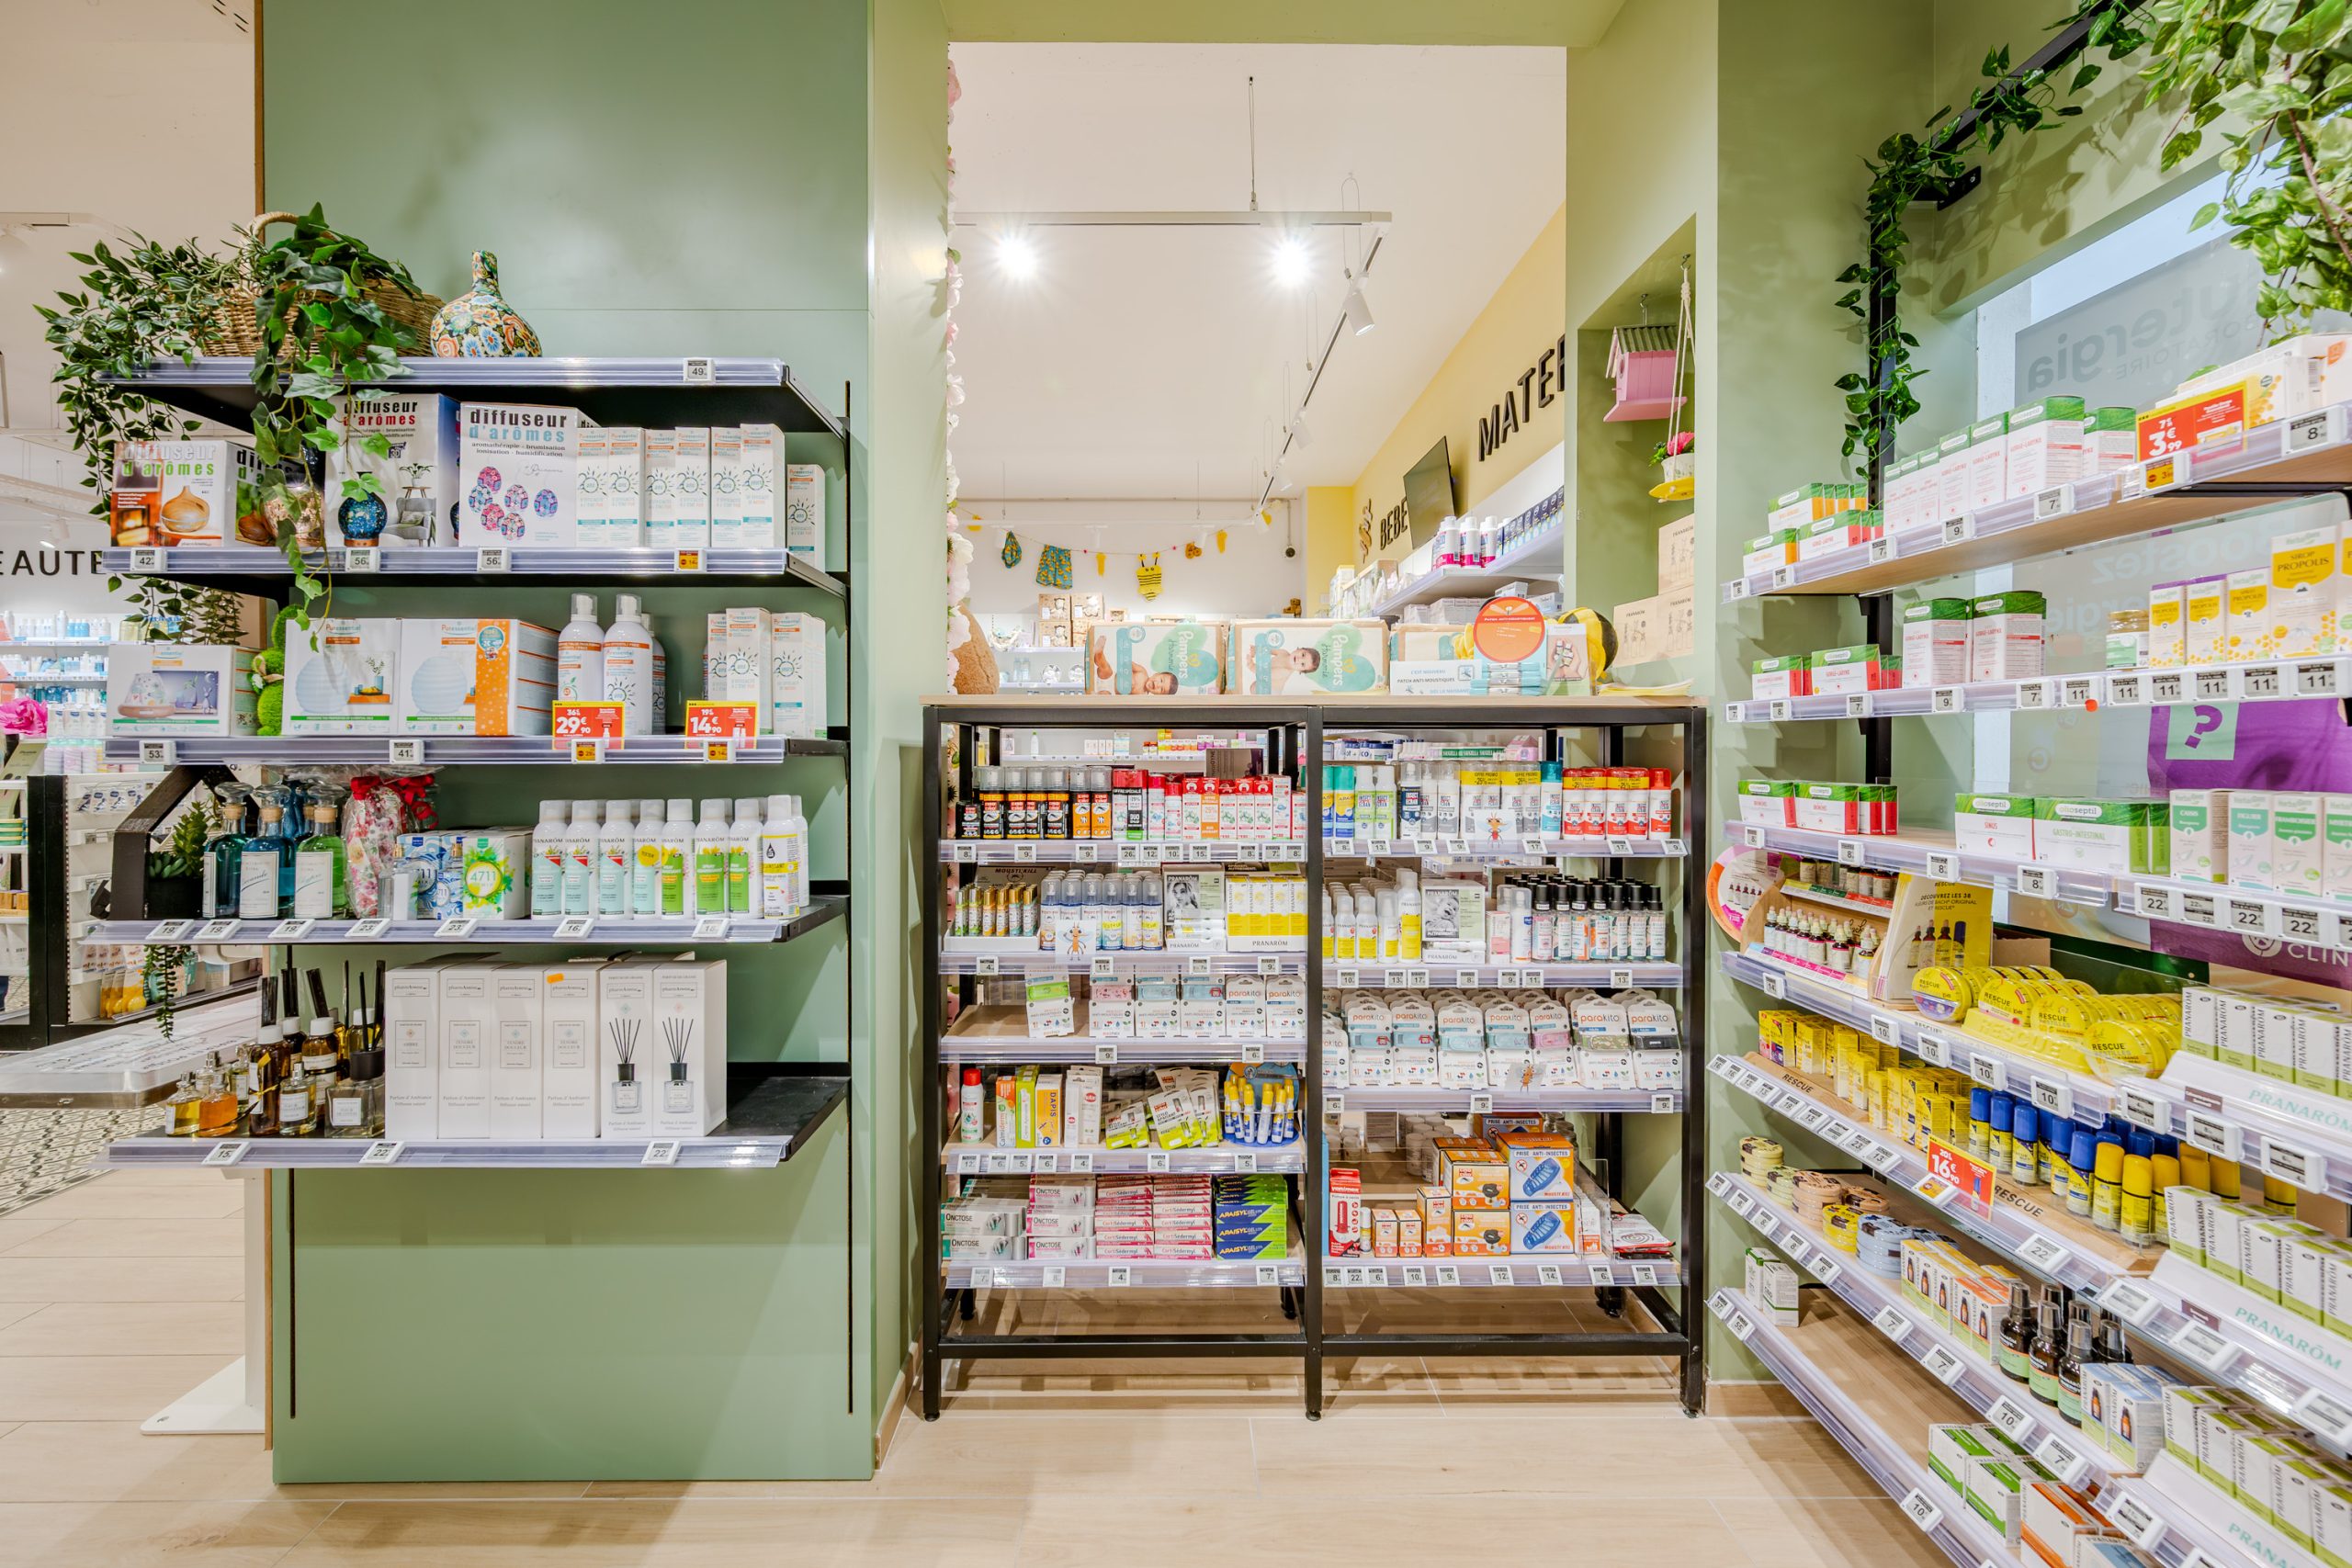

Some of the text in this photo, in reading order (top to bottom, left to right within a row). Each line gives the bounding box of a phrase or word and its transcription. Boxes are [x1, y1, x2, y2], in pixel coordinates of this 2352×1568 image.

[469, 408, 568, 428] diffuseur
[469, 425, 566, 444] d'arômes
[122, 443, 216, 461] diffuseur
[121, 460, 215, 477] d'arômes
[0, 549, 103, 576] AUTE
[2278, 557, 2330, 572] PROPOLIS
[1177, 630, 1195, 680] Pampers
[1329, 632, 1350, 688] Pampers
[469, 871, 498, 884] 4711
[2038, 1012, 2067, 1022] RESCUE
[2091, 1043, 2125, 1051] RESCUE
[1782, 1073, 1814, 1094] RESCUE
[1994, 1185, 2044, 1218] RESCUE
[2234, 1306, 2343, 1371] PRANARÔM
